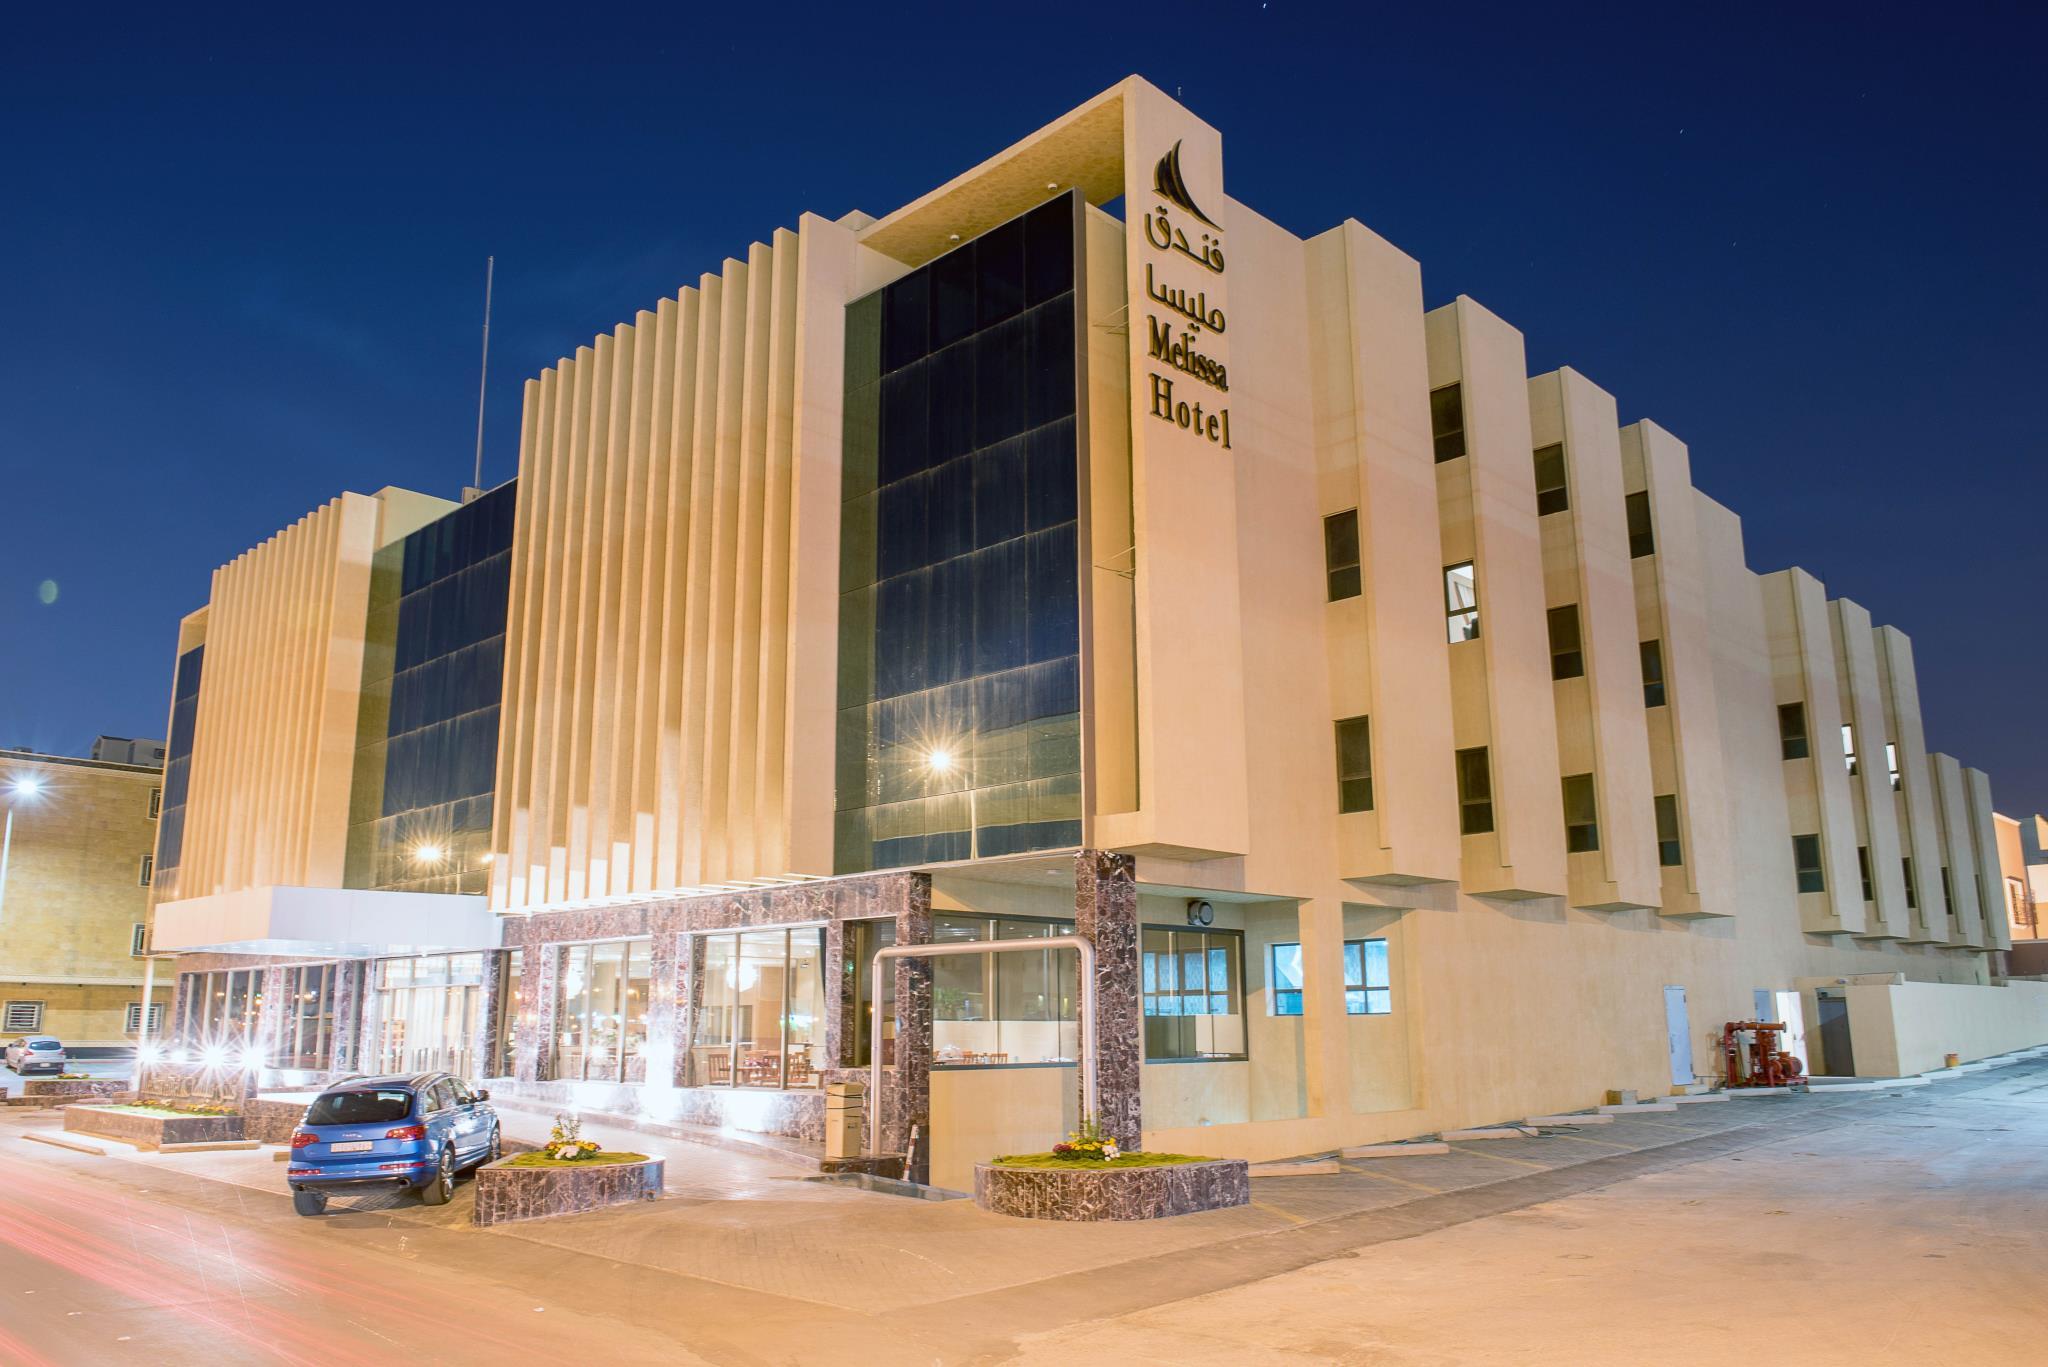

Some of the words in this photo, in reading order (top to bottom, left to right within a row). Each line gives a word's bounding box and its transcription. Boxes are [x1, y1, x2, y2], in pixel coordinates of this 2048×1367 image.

[1144, 205, 1224, 273] فندق
[1146, 263, 1225, 334] مليسا
[1147, 314, 1229, 392] Melissa
[1148, 372, 1231, 450] Hotel
